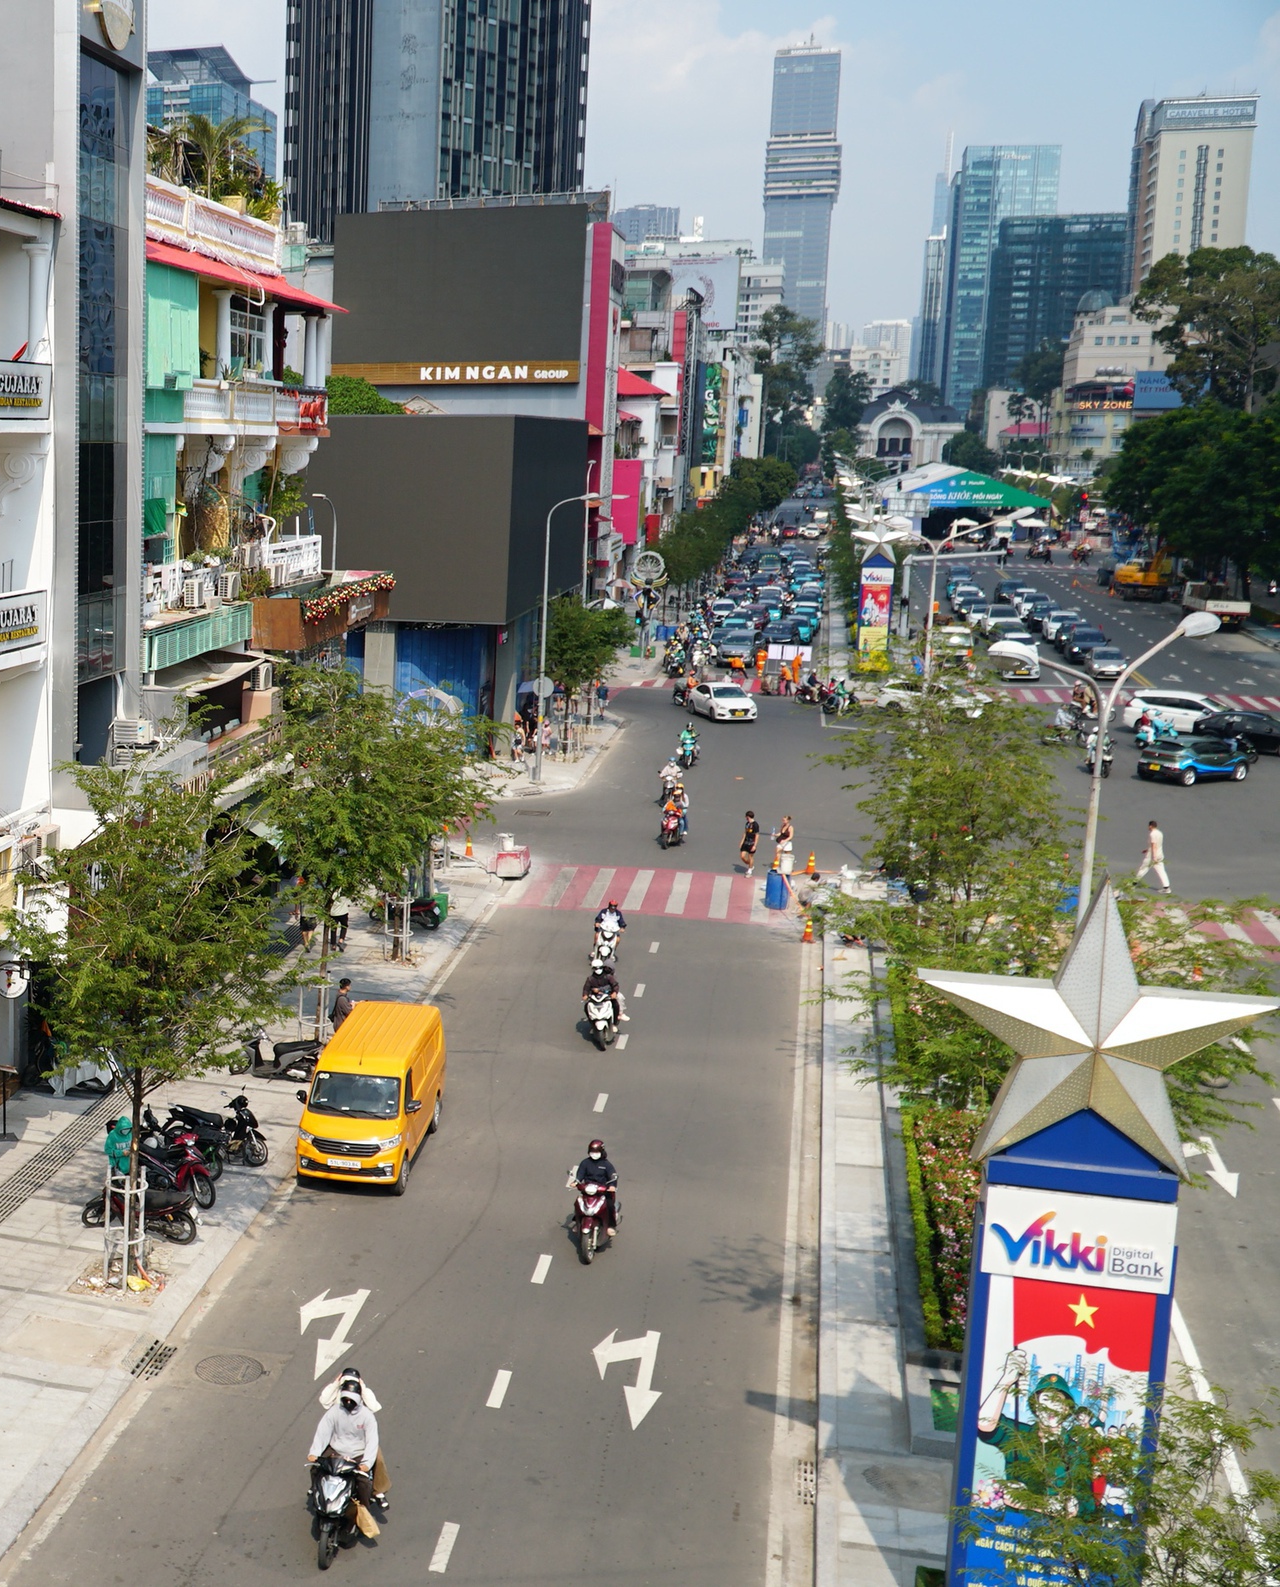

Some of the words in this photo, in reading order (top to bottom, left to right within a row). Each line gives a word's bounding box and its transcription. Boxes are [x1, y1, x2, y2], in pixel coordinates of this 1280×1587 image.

[1169, 108, 1219, 118] CARAVELLE
[1222, 107, 1251, 116] HOTEL
[420, 366, 460, 381] KIM
[465, 365, 528, 380] NGAN
[534, 369, 569, 379] GROUP
[14, 397, 43, 407] RESTAURANT
[1079, 401, 1100, 409] SKY
[1103, 401, 1133, 409] ZONE
[11, 626, 39, 640] RESTAURANT
[990, 1211, 1108, 1272] Vikki
[1112, 1247, 1153, 1260] Digital
[1112, 1258, 1164, 1278] Bank
[995, 1540, 1014, 1552] CÁCH
